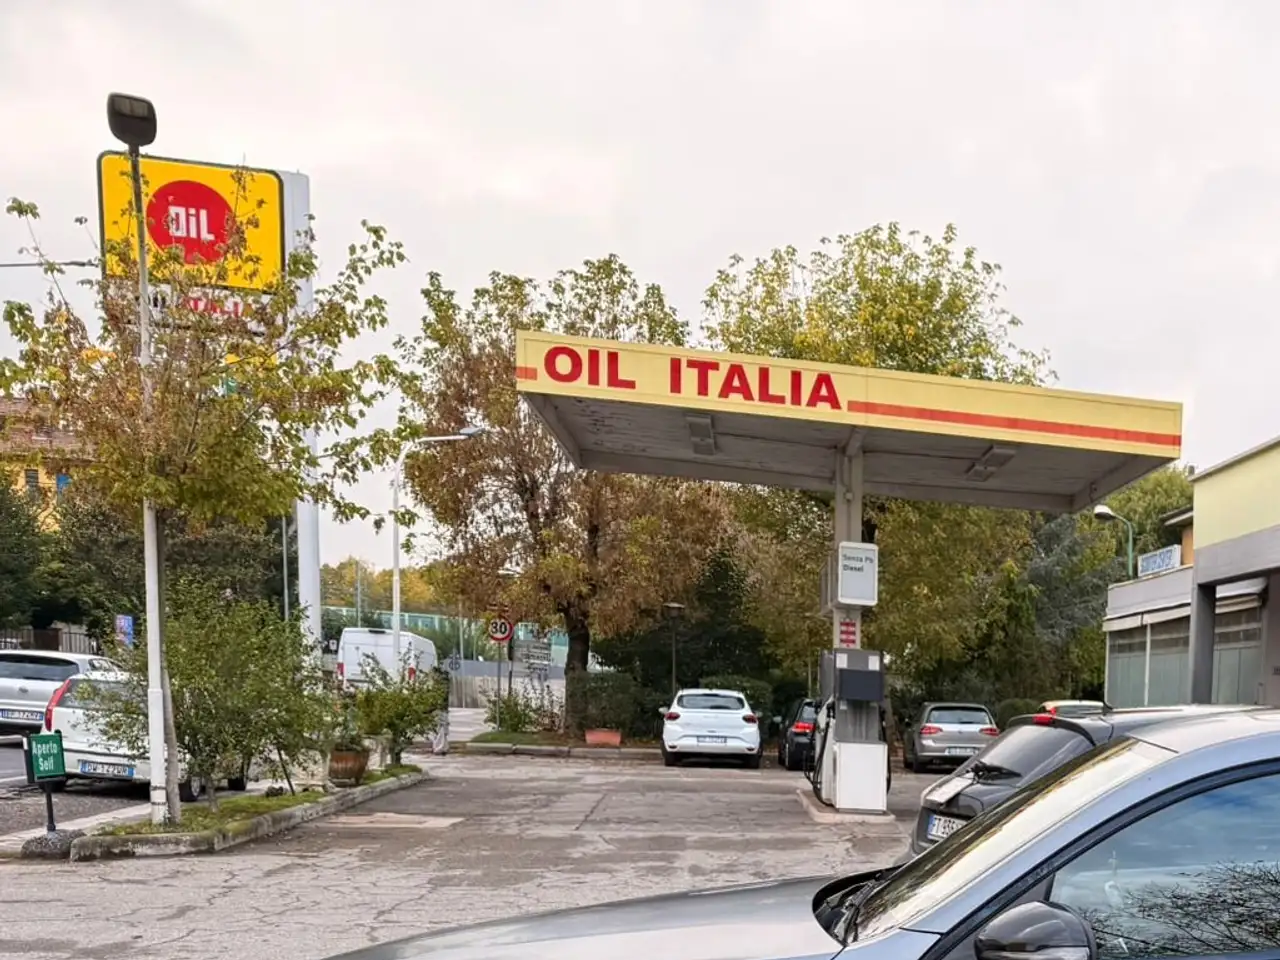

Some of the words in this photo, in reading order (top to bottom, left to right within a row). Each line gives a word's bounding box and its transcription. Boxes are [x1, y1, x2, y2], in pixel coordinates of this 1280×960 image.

[544, 346, 636, 390] OIL
[670, 357, 841, 410] ITALIA
[842, 554, 863, 563] Senza
[842, 564, 864, 573] Diesel
[491, 621, 507, 635] 30
[32, 741, 58, 756] Aperto
[38, 758, 54, 771] Self
